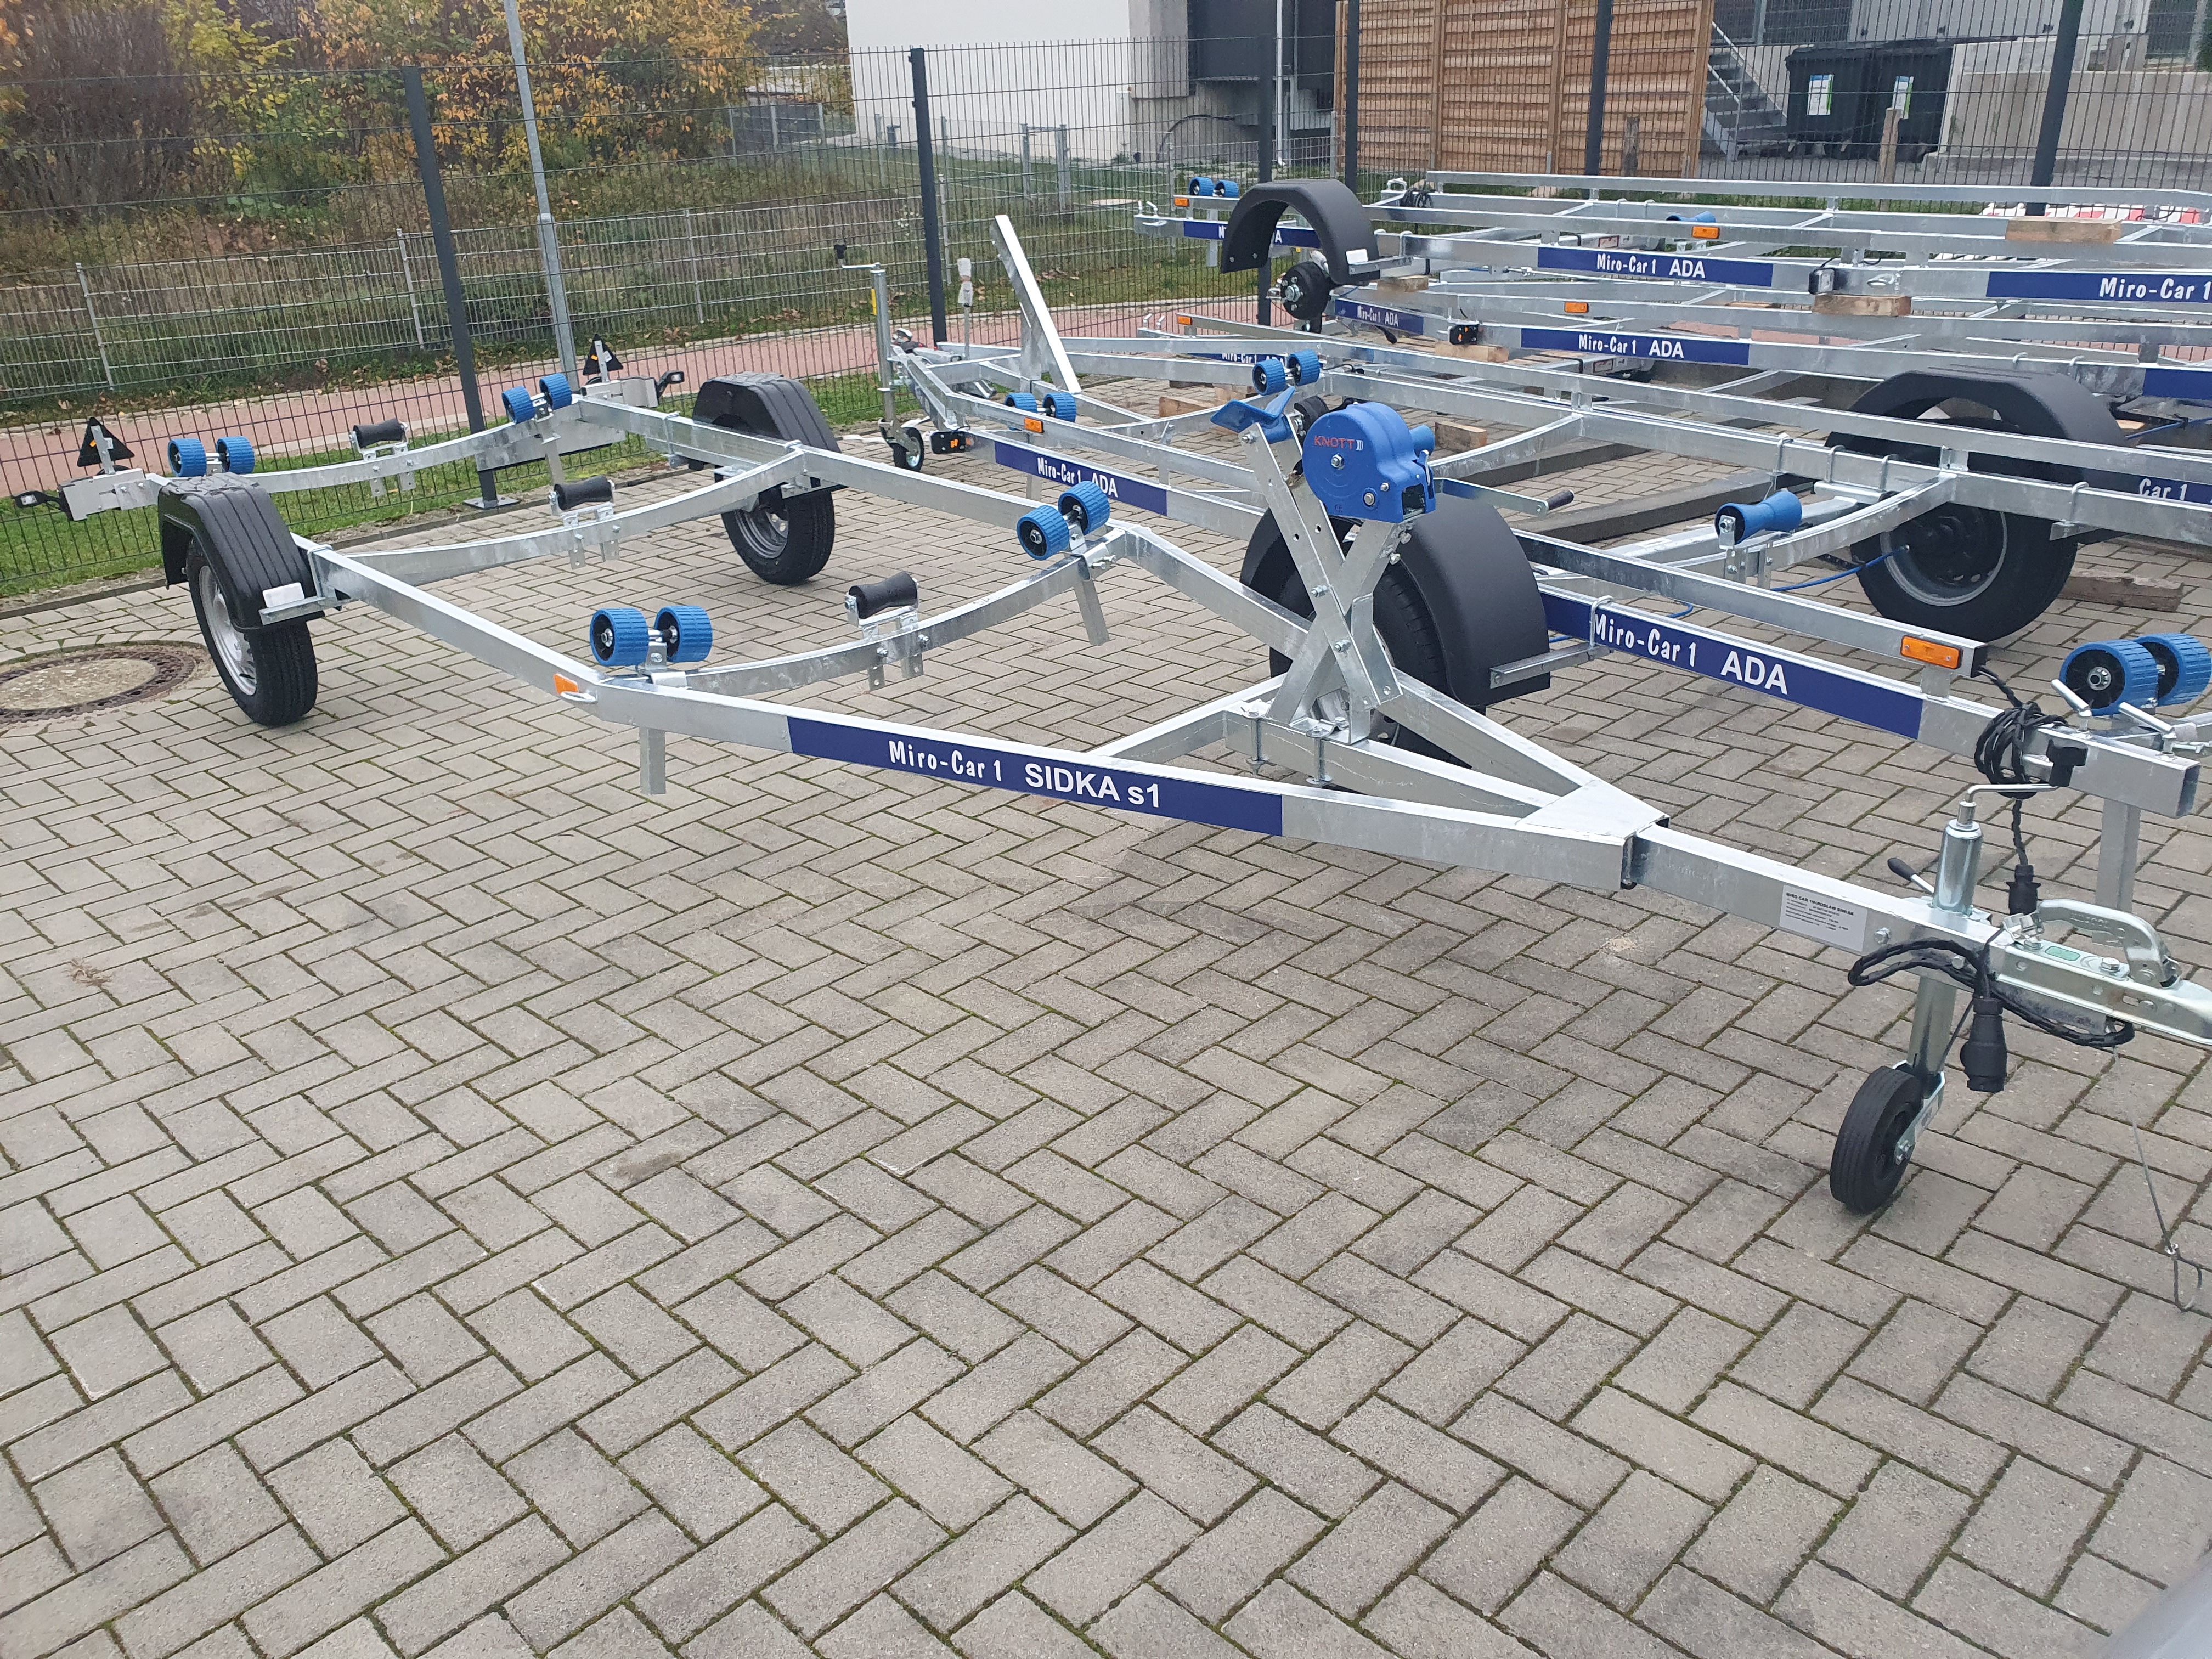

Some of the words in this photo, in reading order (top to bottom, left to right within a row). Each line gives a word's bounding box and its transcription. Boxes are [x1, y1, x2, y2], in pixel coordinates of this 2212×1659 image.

[1597, 253, 1647, 273] Miro-Car
[1652, 259, 1656, 274] 1
[1669, 259, 1706, 278] ADA
[2099, 276, 2195, 300] Miro-Car
[2203, 281, 2212, 300] 1
[1357, 305, 1378, 322] Miro-Car
[1384, 312, 1399, 327] ADA
[1578, 334, 1628, 354] Miro-Car
[1632, 340, 1637, 354] 1
[1649, 340, 1684, 358] ADA
[1314, 436, 1355, 449] KNOTT
[1037, 457, 1075, 484] Miro-Car
[2180, 483, 2188, 501] 1
[1595, 613, 1680, 662] Miro-Car
[1689, 642, 1696, 667] 1
[1720, 651, 1788, 695] ADA
[889, 740, 985, 778] Miro-Car
[994, 759, 1002, 781] 1
[1025, 763, 1120, 802] SIDKA
[1128, 783, 1159, 808] s1
